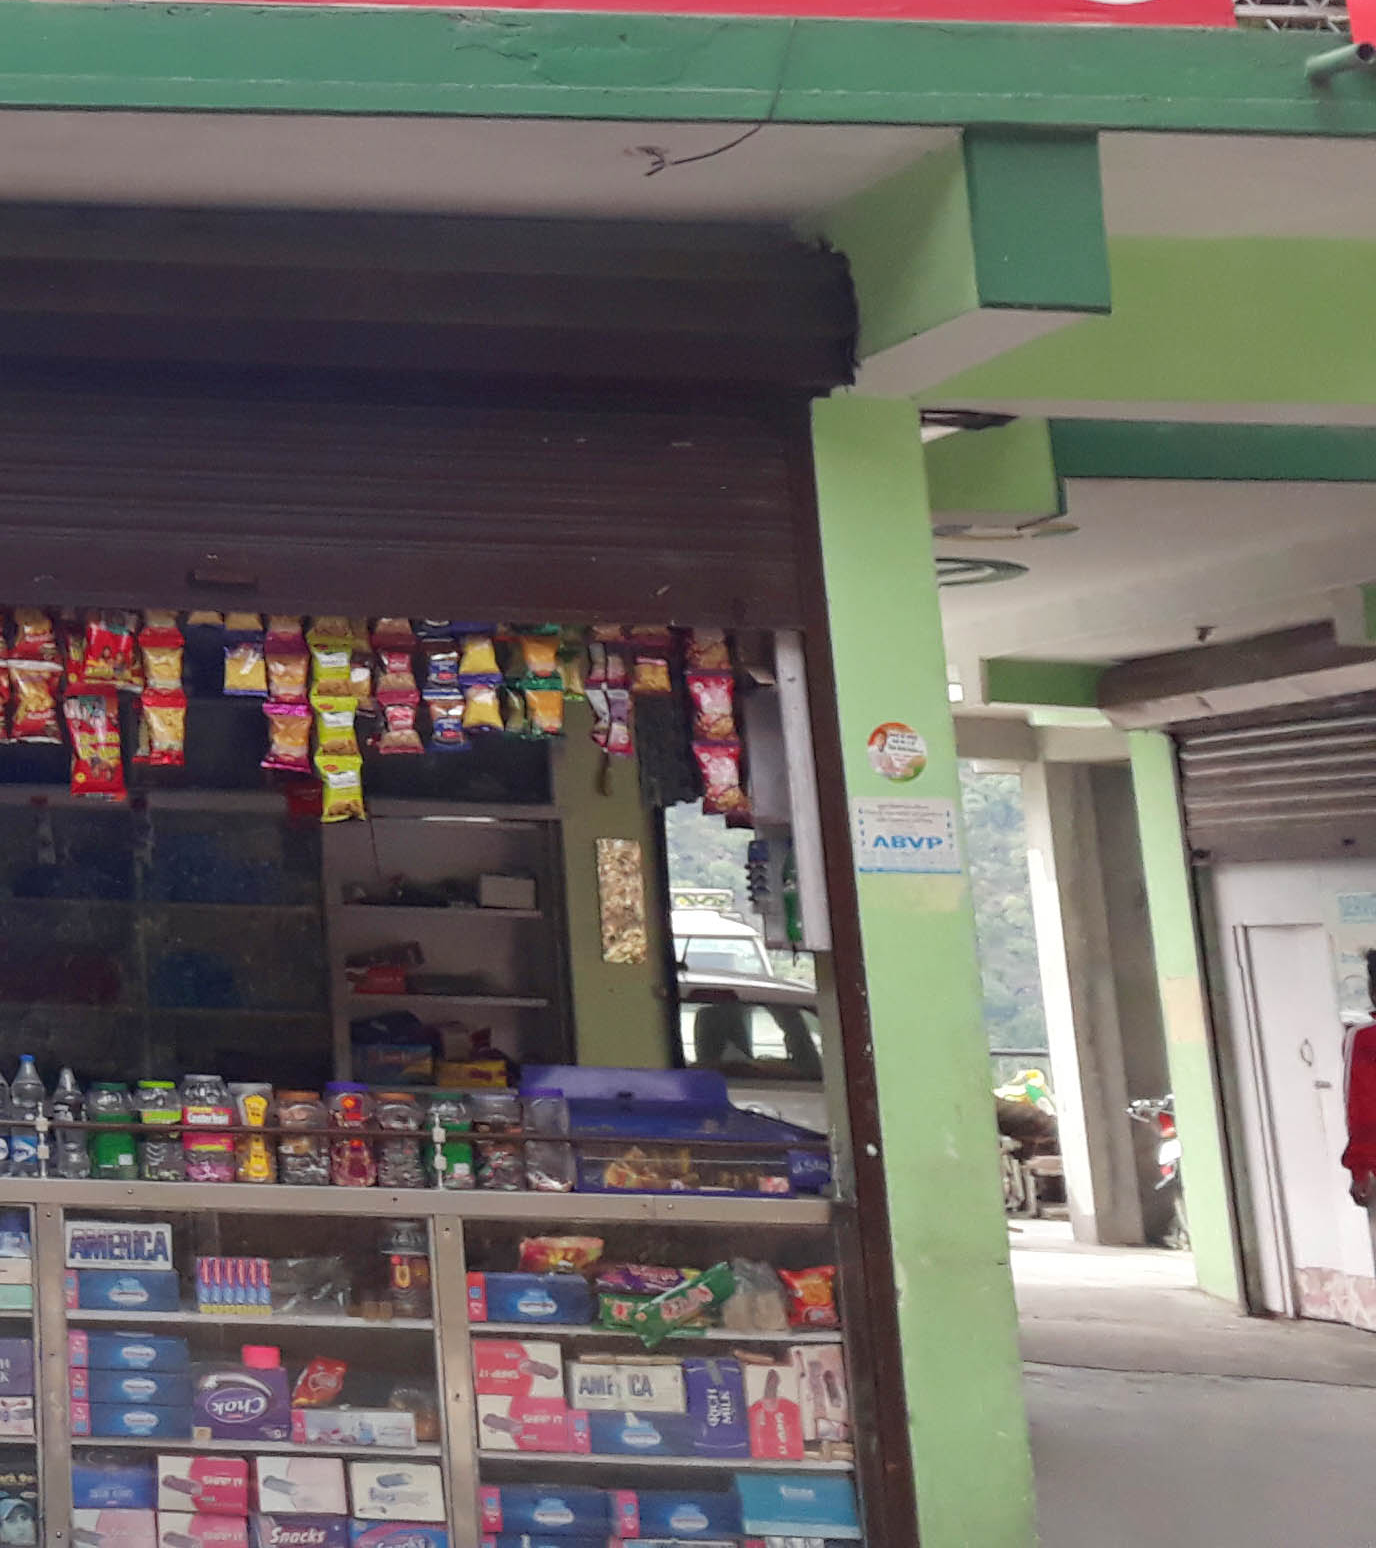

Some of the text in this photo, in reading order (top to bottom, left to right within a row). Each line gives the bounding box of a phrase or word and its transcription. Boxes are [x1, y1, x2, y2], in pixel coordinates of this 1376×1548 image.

[873, 835, 944, 850] ABVP
[69, 1228, 169, 1261] AMERICA
[269, 1526, 327, 1544] Snacks
